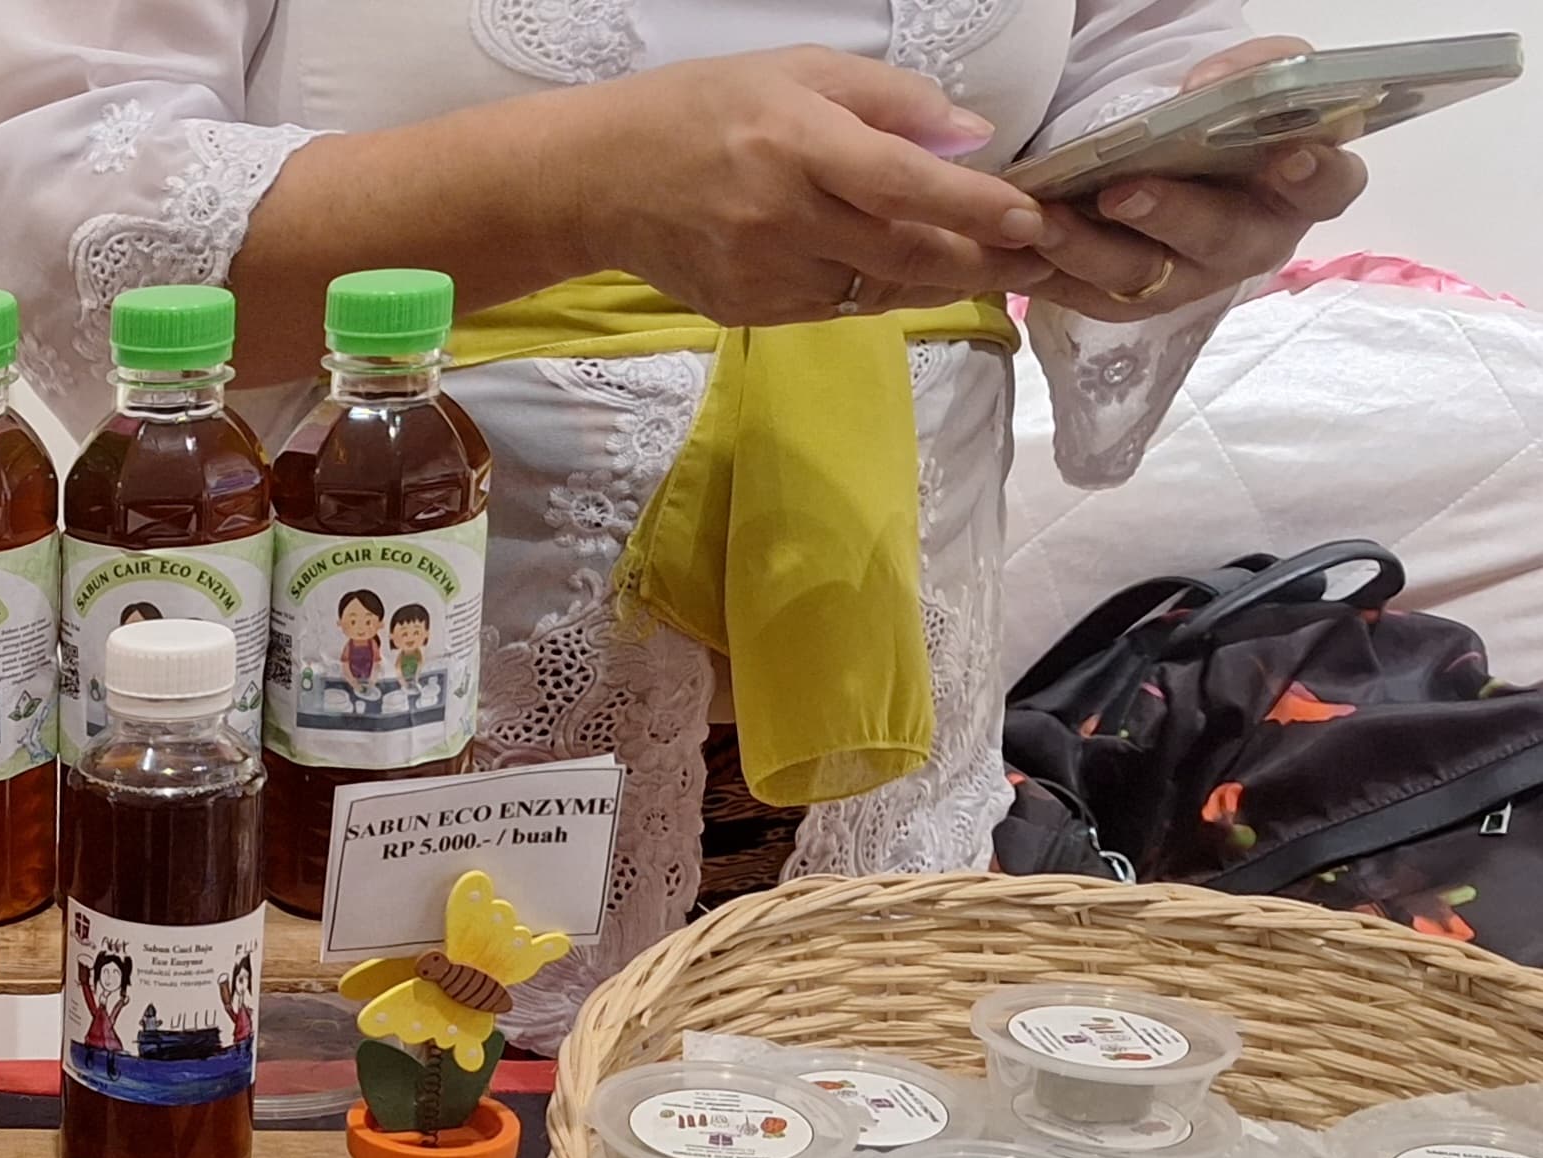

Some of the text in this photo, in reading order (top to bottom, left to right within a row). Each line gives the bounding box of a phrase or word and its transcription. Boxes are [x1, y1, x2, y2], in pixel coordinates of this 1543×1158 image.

[76, 560, 236, 611] SABUN CAIR ECO ENZYM
[291, 547, 455, 599] SABUN CAIR ECO ENZYM
[346, 797, 617, 842] SABUN ECO ENZYME
[382, 841, 415, 860] RP
[512, 826, 568, 845] buah
